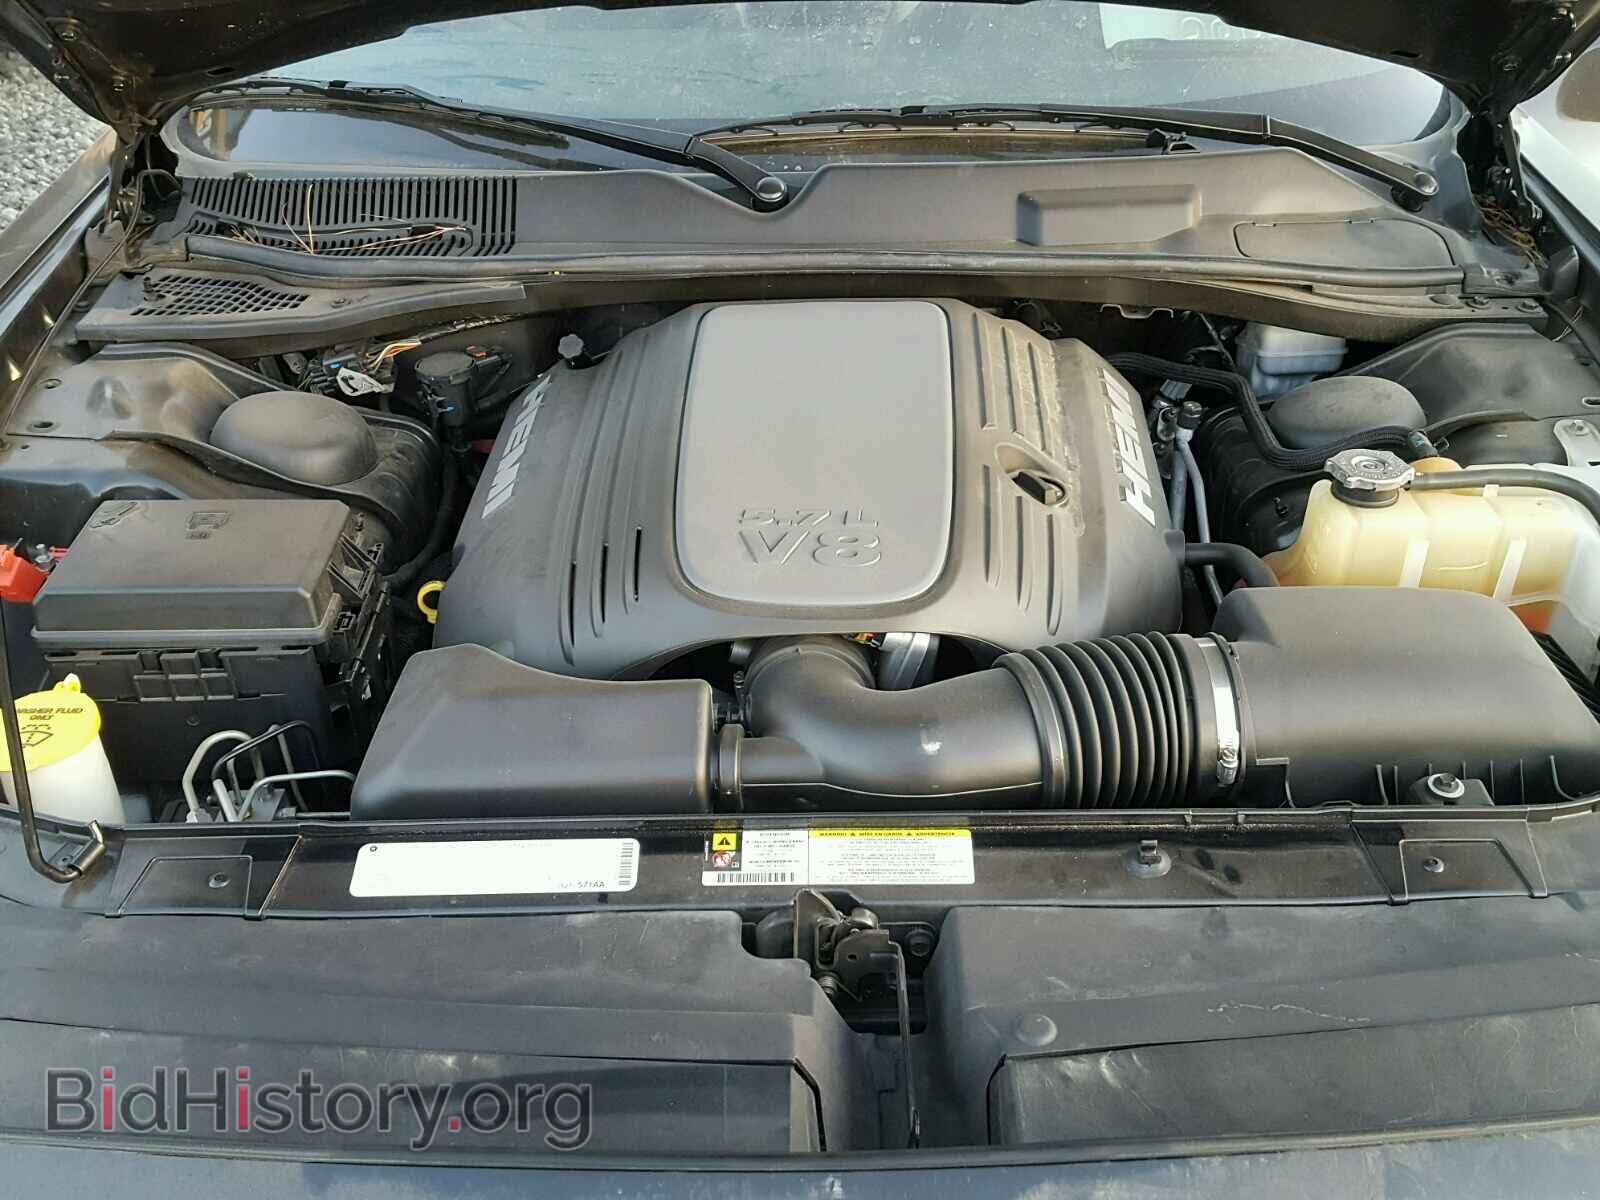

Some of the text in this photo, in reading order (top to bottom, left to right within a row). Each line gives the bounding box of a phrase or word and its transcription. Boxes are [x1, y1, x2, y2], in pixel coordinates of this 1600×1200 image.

[481, 374, 551, 519] HEMI
[1103, 367, 1156, 528] HEMI
[738, 508, 879, 528] 5.7L
[738, 529, 882, 567] V8
